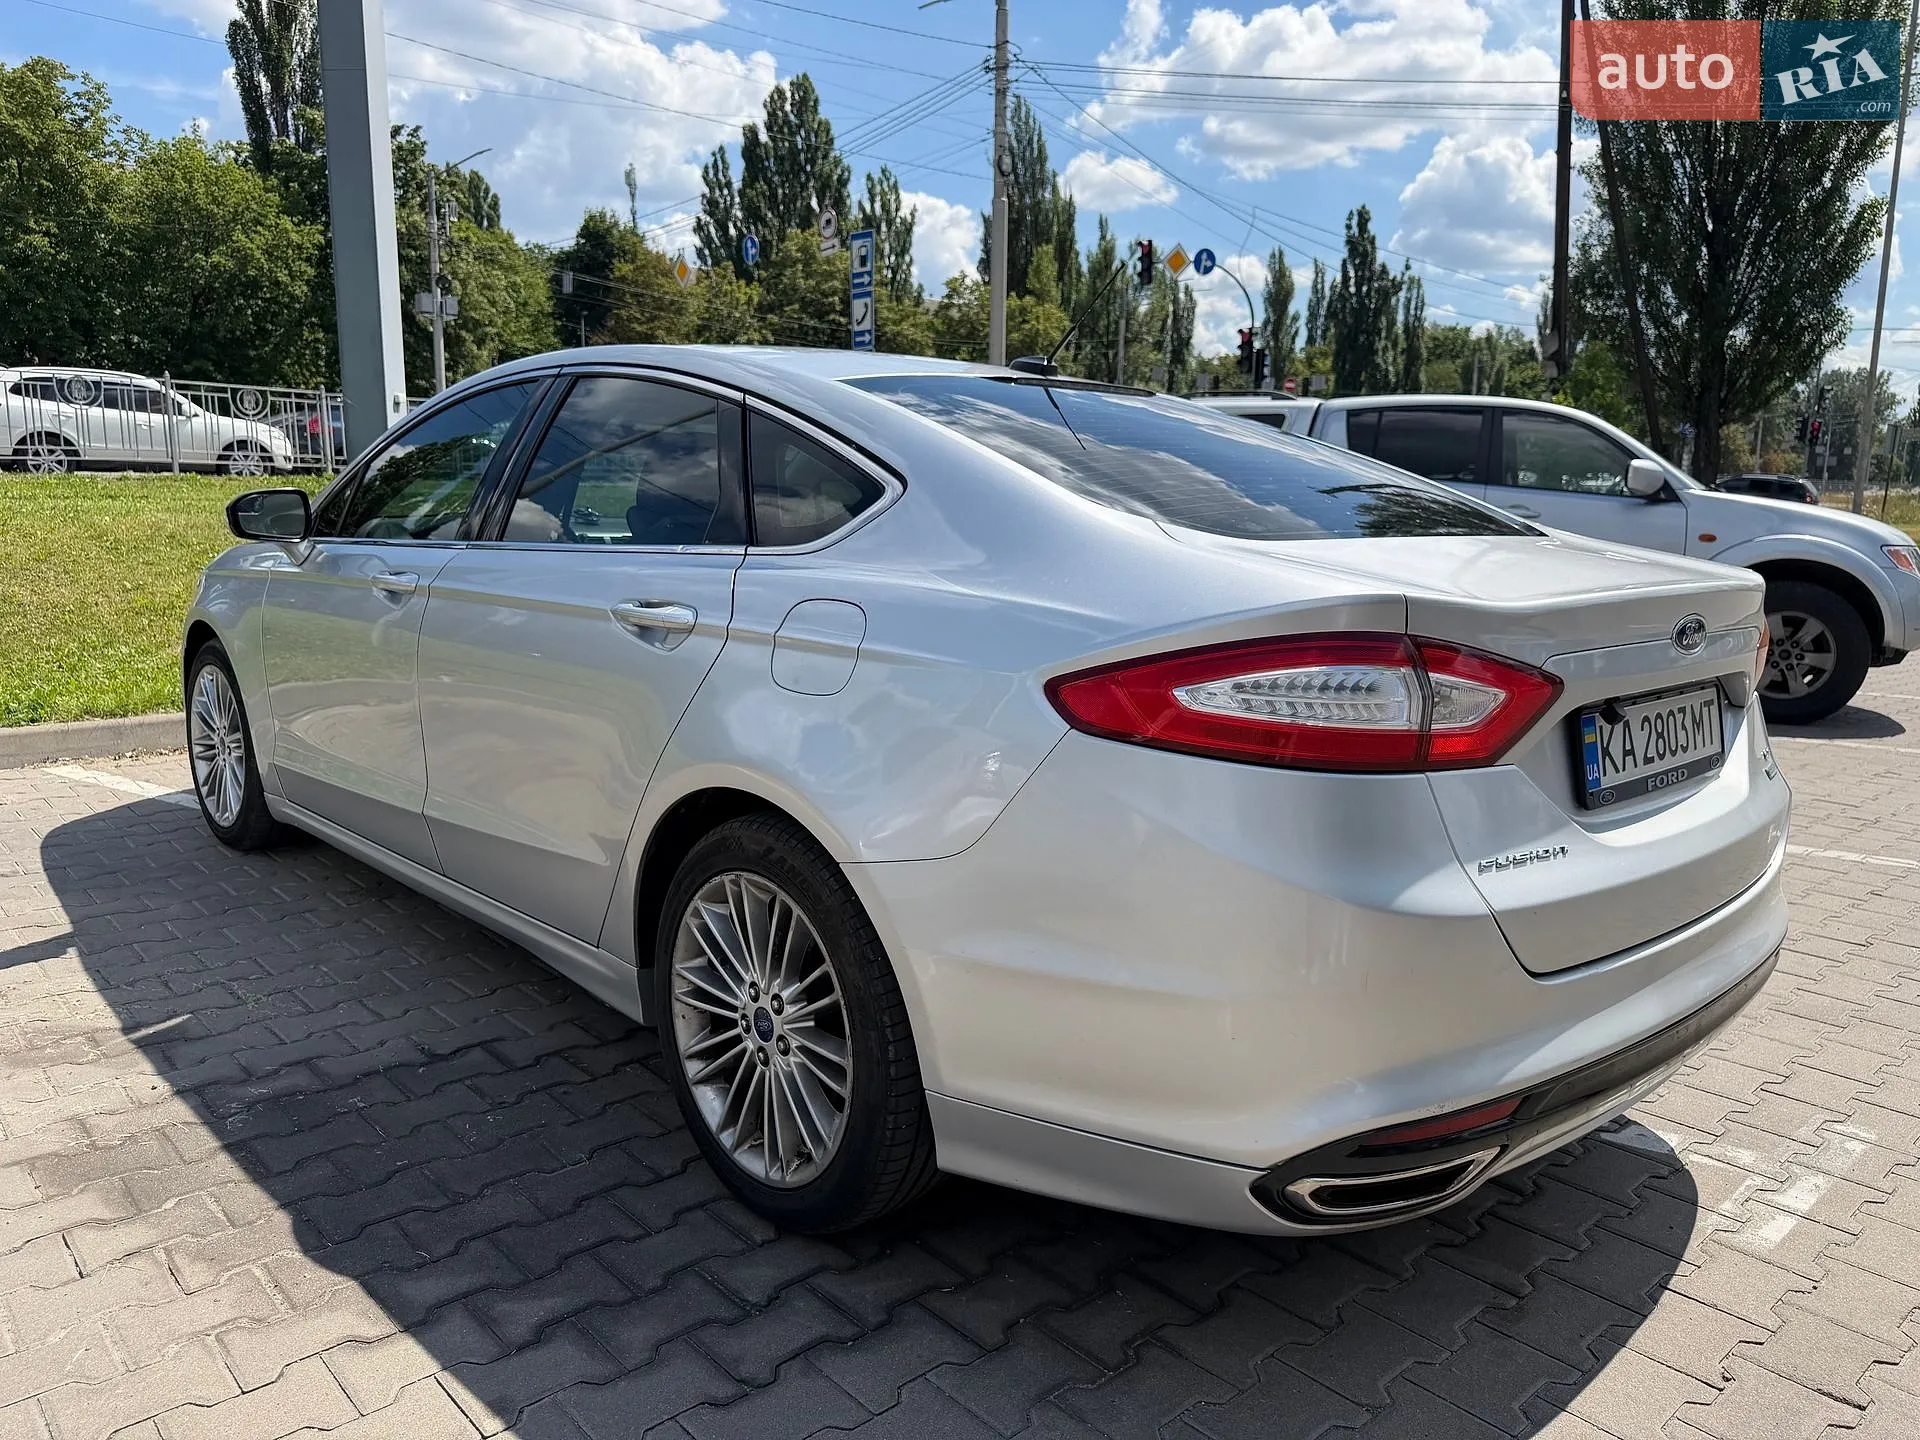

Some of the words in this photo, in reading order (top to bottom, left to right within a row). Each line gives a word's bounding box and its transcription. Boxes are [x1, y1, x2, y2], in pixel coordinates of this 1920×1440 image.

[1599, 718, 1638, 777] KA
[1640, 705, 1689, 766] 2803
[1690, 699, 1715, 751] MT
[1587, 763, 1599, 780] UA
[1647, 768, 1688, 792] FORD
[1478, 845, 1569, 876] FUSION
